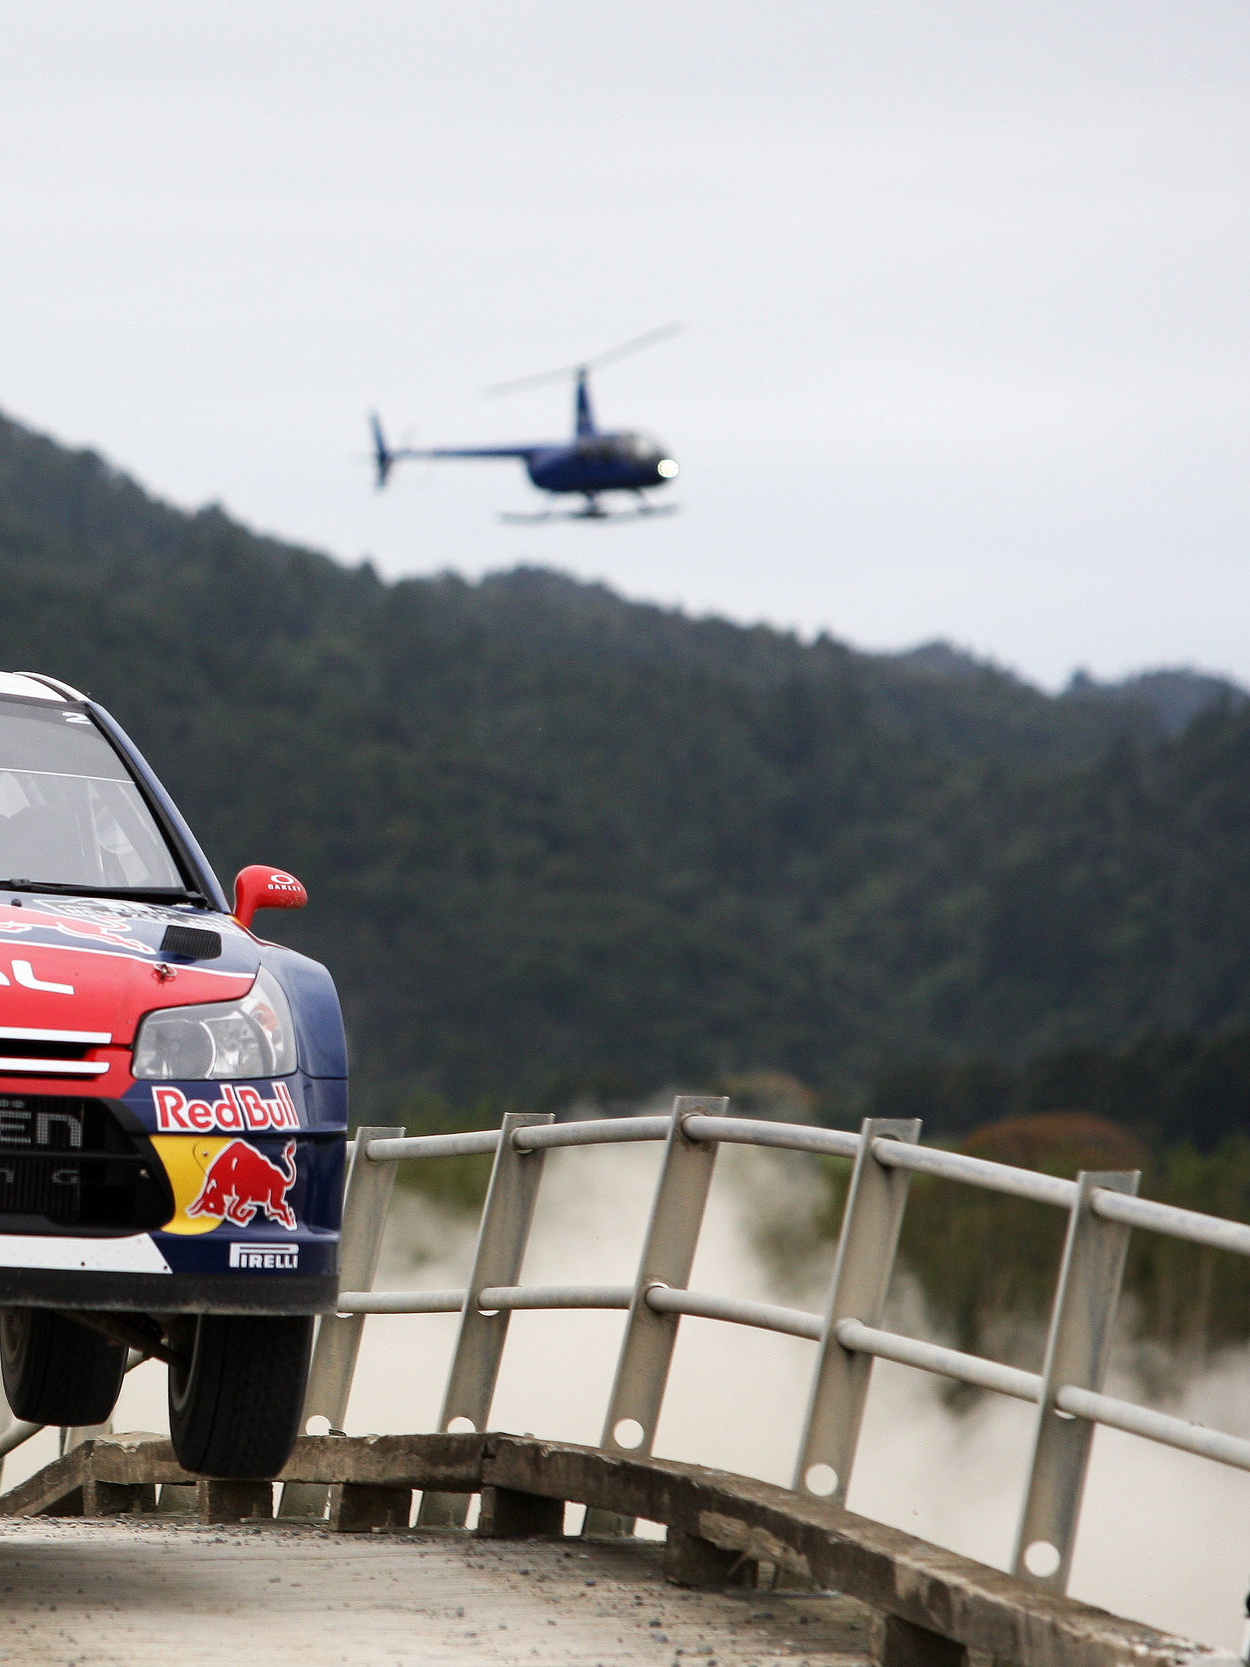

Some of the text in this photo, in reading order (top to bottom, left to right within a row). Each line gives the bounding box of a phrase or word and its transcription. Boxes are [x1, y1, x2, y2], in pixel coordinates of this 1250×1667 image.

[152, 1081, 300, 1131] Red Bull
[229, 1242, 299, 1269] PIRELLI
